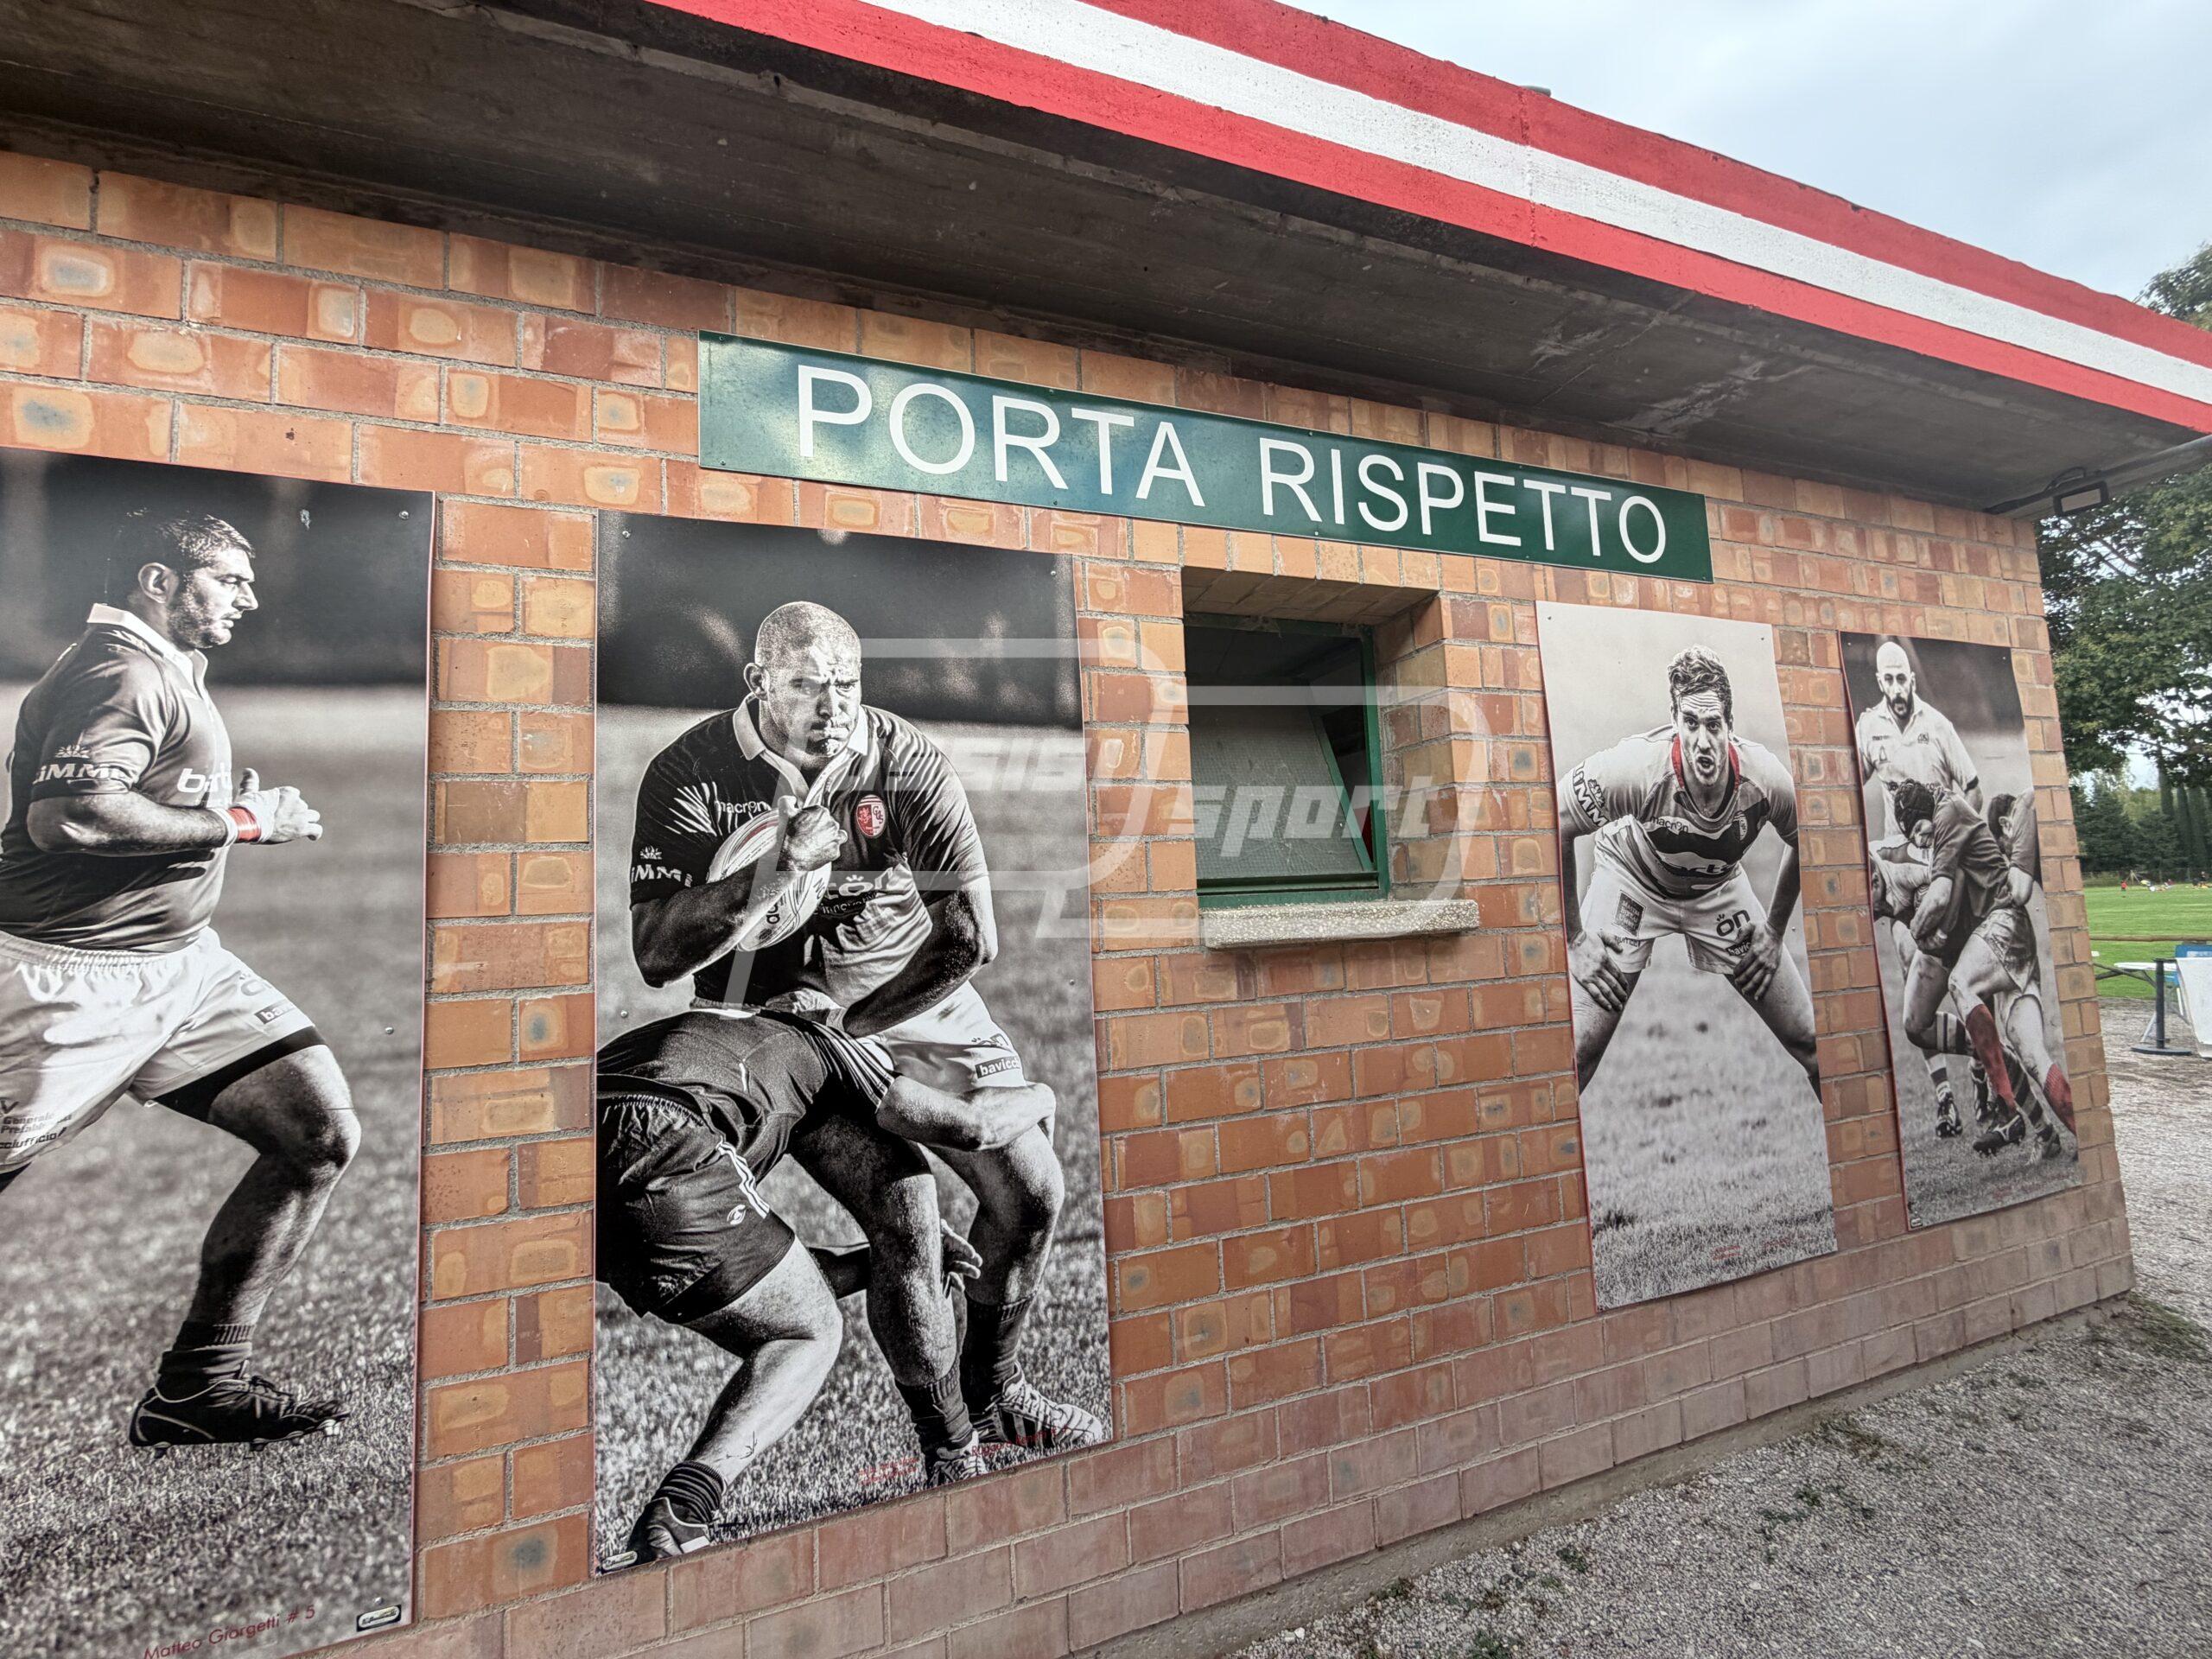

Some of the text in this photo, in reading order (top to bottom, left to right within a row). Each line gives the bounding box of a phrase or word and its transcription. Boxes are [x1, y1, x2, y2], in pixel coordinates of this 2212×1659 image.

[797, 365, 1668, 565] PORTA RISPETTO
[143, 1605, 315, 1659] Matteo Giorgetti # 5
